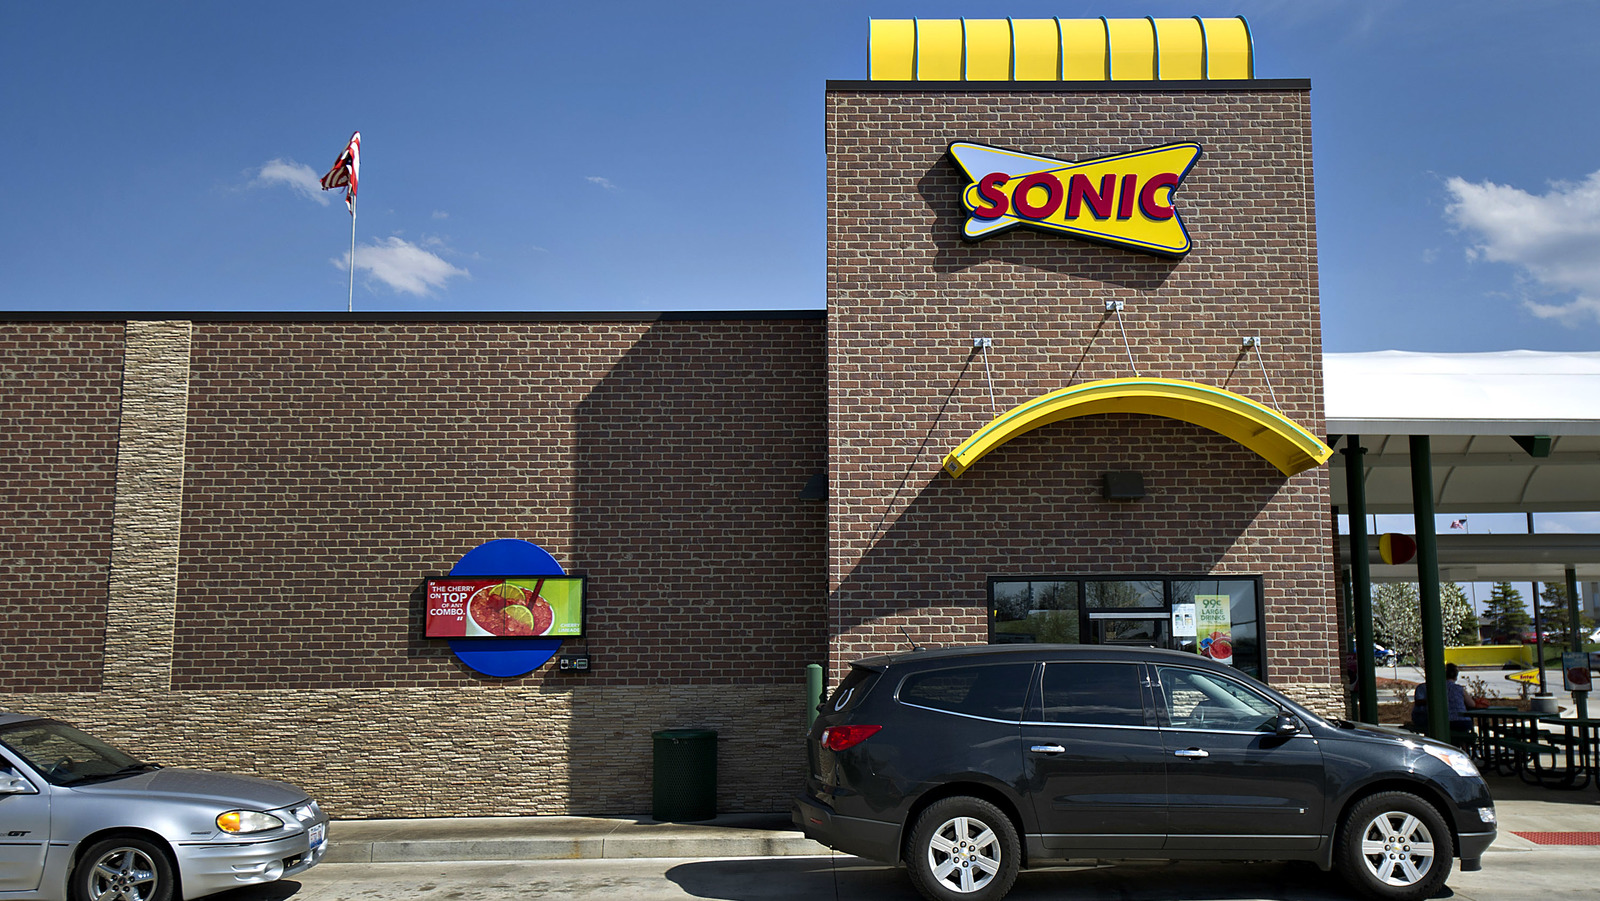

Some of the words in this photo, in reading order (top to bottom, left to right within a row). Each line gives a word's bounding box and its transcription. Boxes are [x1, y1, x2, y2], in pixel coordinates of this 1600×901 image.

[974, 172, 1179, 220] SONIC
[442, 593, 467, 603] TOP
[430, 608, 466, 616] COMBO.
